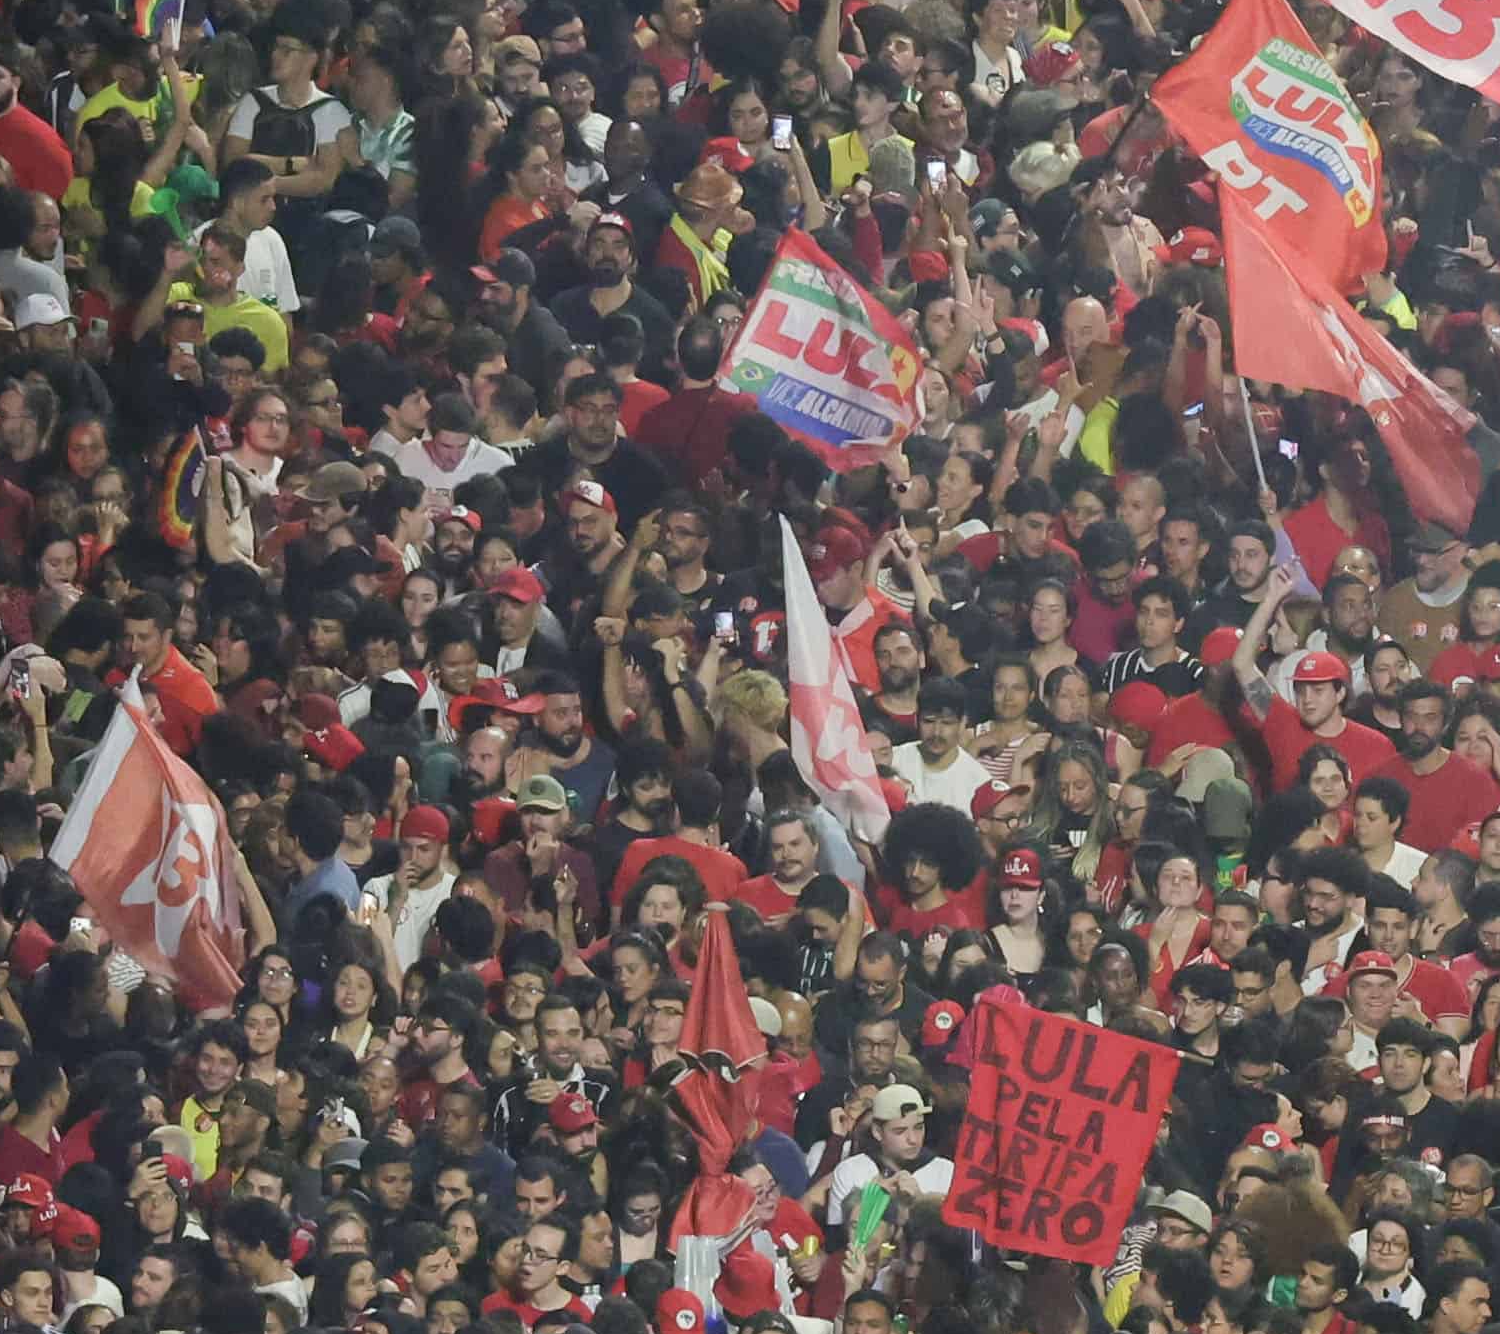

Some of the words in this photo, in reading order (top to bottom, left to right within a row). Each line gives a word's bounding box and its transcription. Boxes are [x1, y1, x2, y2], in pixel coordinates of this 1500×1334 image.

[1201, 140, 1308, 220] PT
[1005, 861, 1031, 875] LULA
[980, 1005, 1149, 1114] LULA
[997, 1074, 1106, 1154] PELA
[955, 1167, 1104, 1246] ZERO
